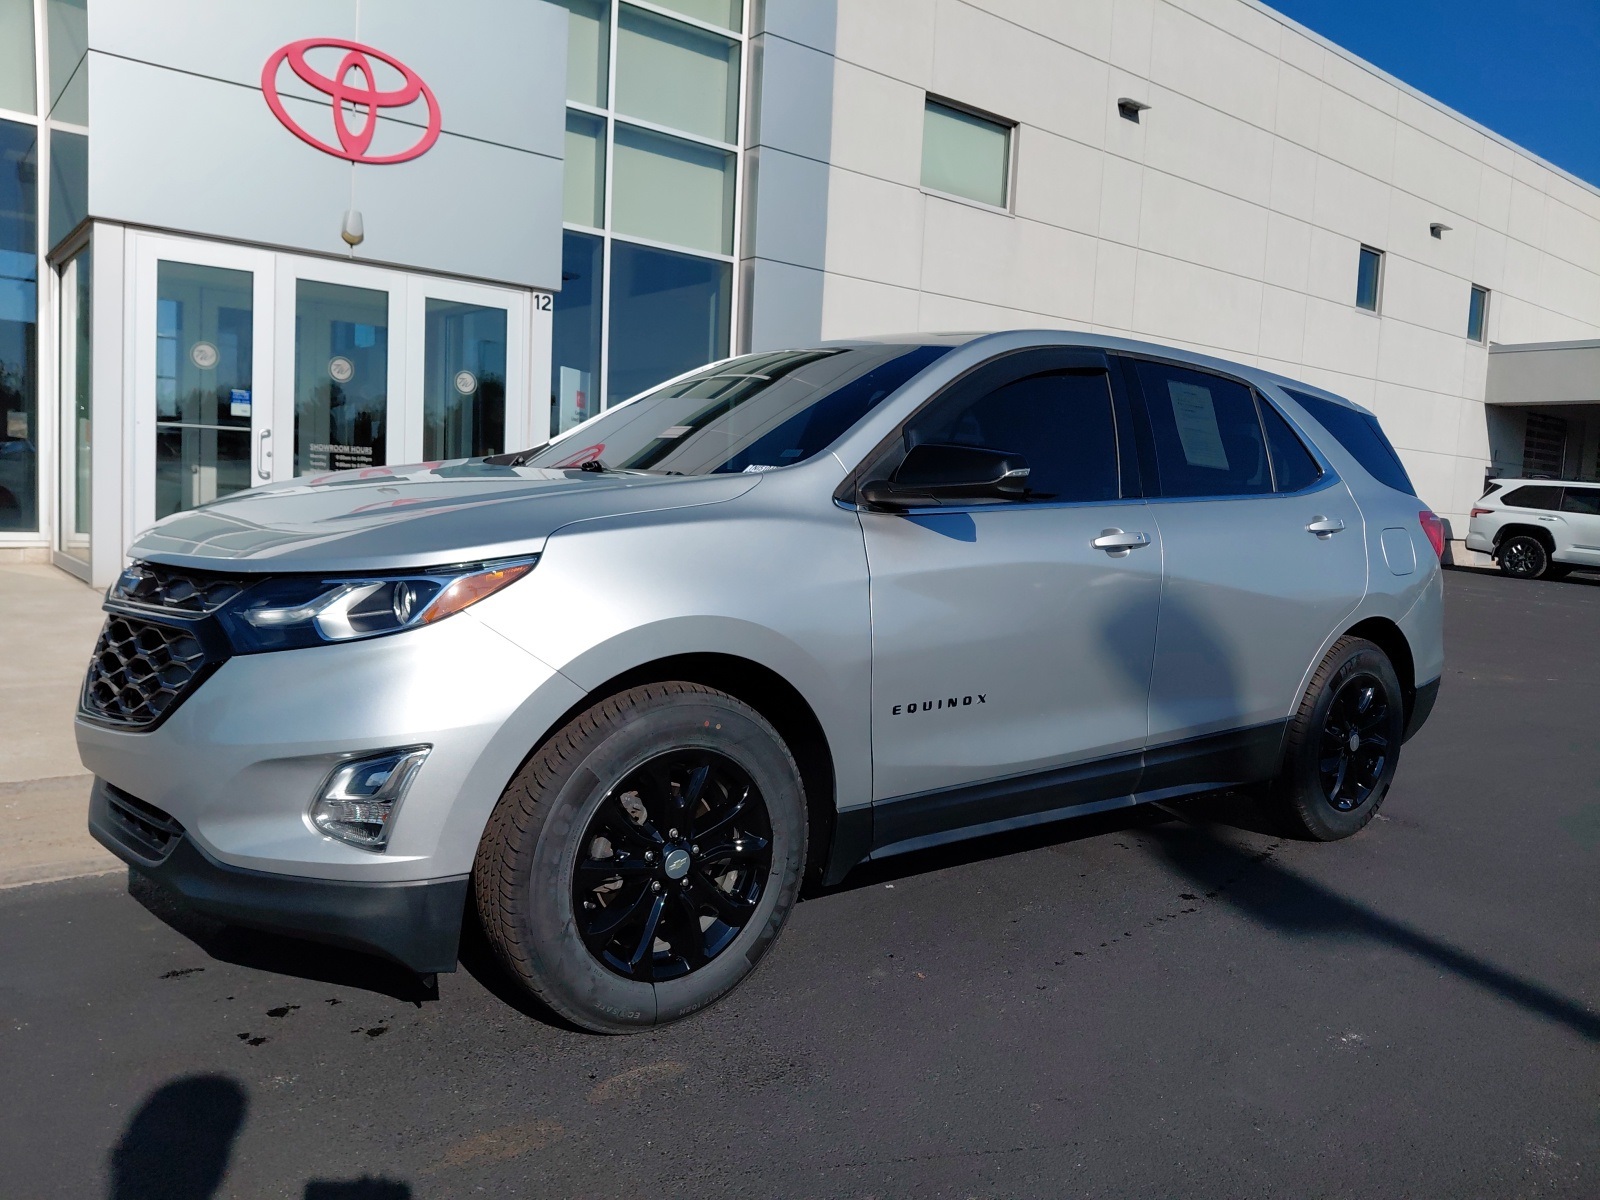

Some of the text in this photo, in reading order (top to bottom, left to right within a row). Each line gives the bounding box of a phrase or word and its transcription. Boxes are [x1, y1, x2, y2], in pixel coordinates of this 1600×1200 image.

[534, 294, 552, 311] 12
[309, 443, 373, 455] SHOWROOM HOURS
[892, 693, 987, 716] EQUINOX
